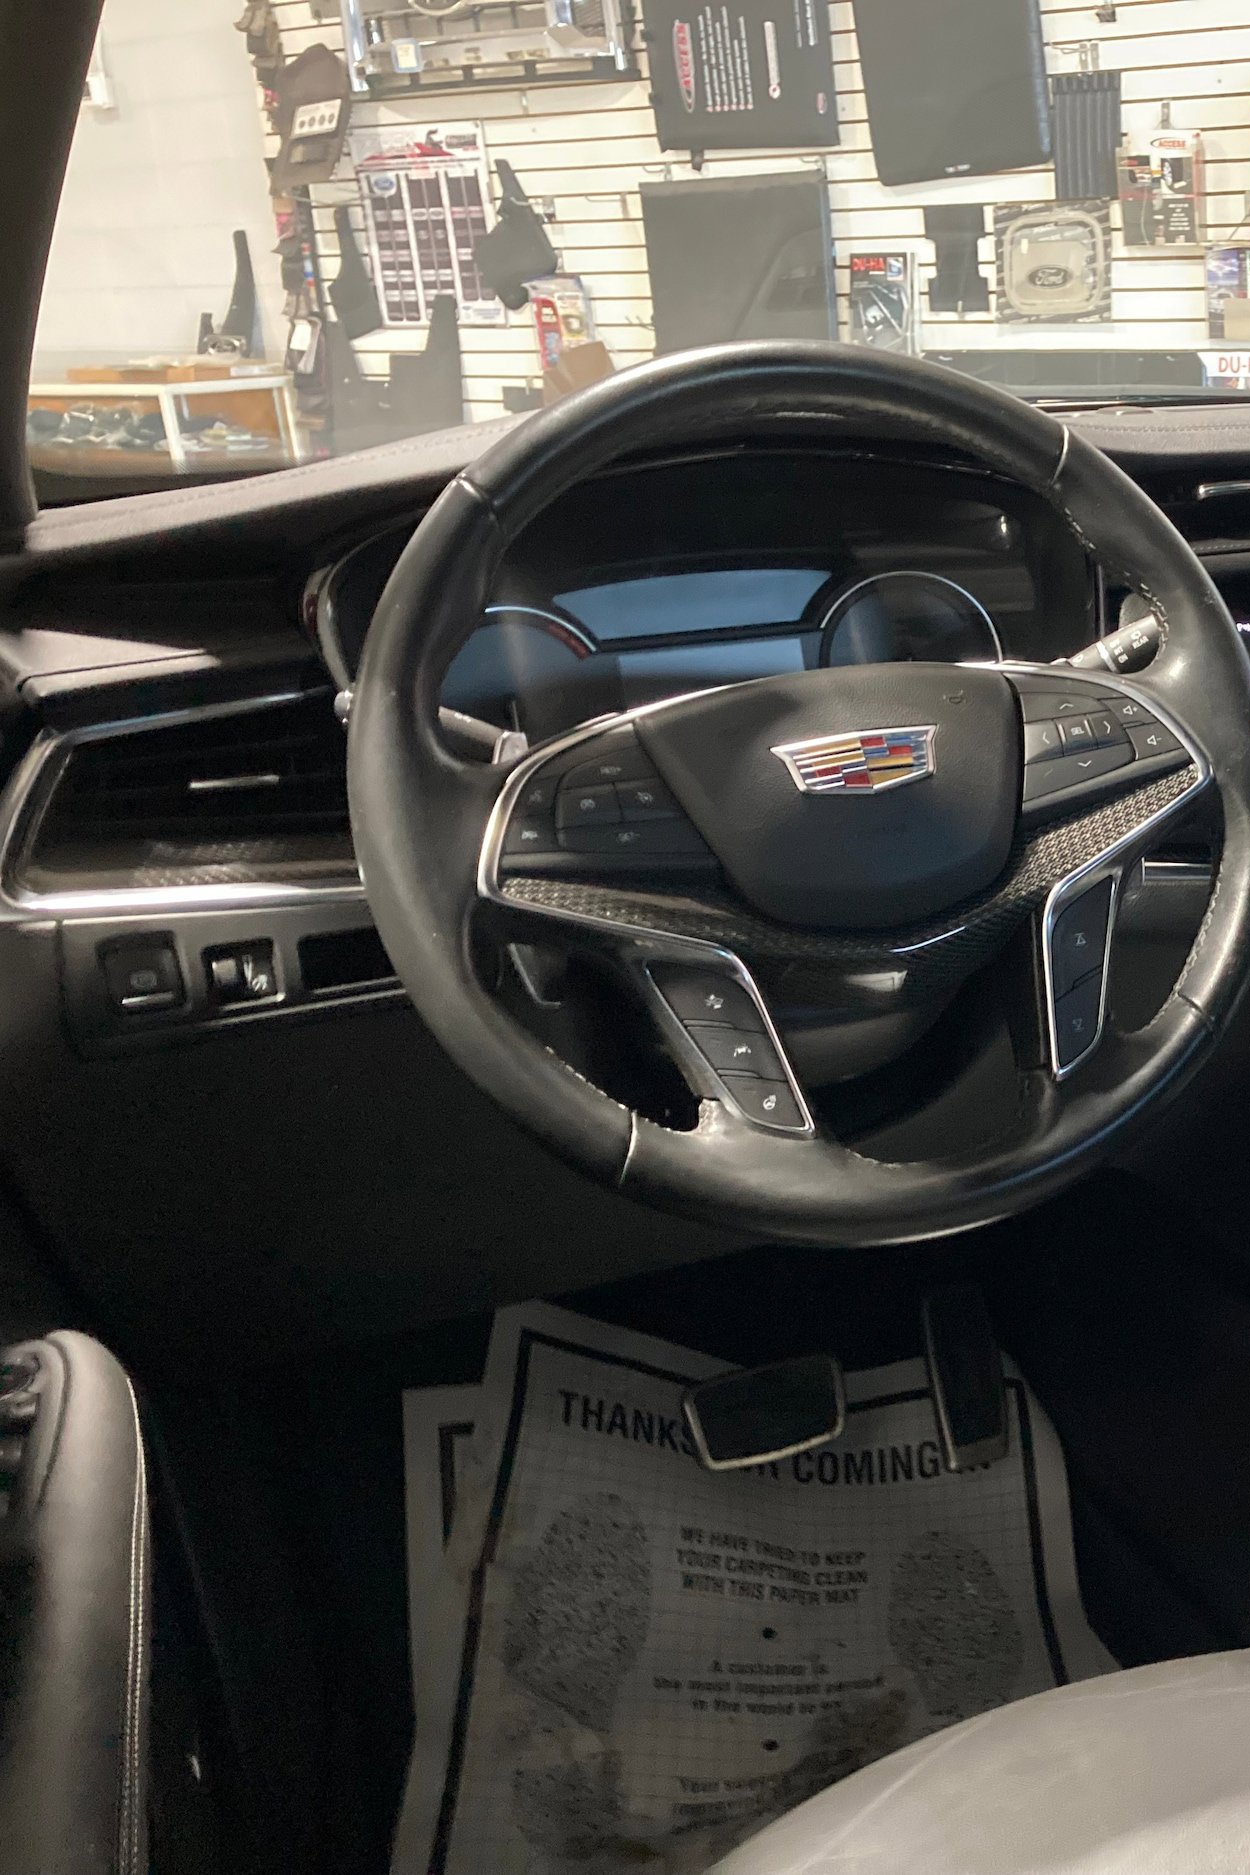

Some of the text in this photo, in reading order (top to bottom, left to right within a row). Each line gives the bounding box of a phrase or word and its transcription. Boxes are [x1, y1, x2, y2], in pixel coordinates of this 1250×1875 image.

[676, 22, 692, 89] ACCESS
[791, 1440, 939, 1487] COMING
[681, 1526, 866, 1566] WE HAVE TRIED TO KEEP
[676, 1548, 868, 1585] YOUR CARPETING CLEAN
[682, 1571, 860, 1605] WITH THIS PAPER MAT
[653, 1676, 683, 1689] the
[687, 1680, 731, 1692] most
[735, 1682, 821, 1695] important
[713, 1697, 741, 1711] the
